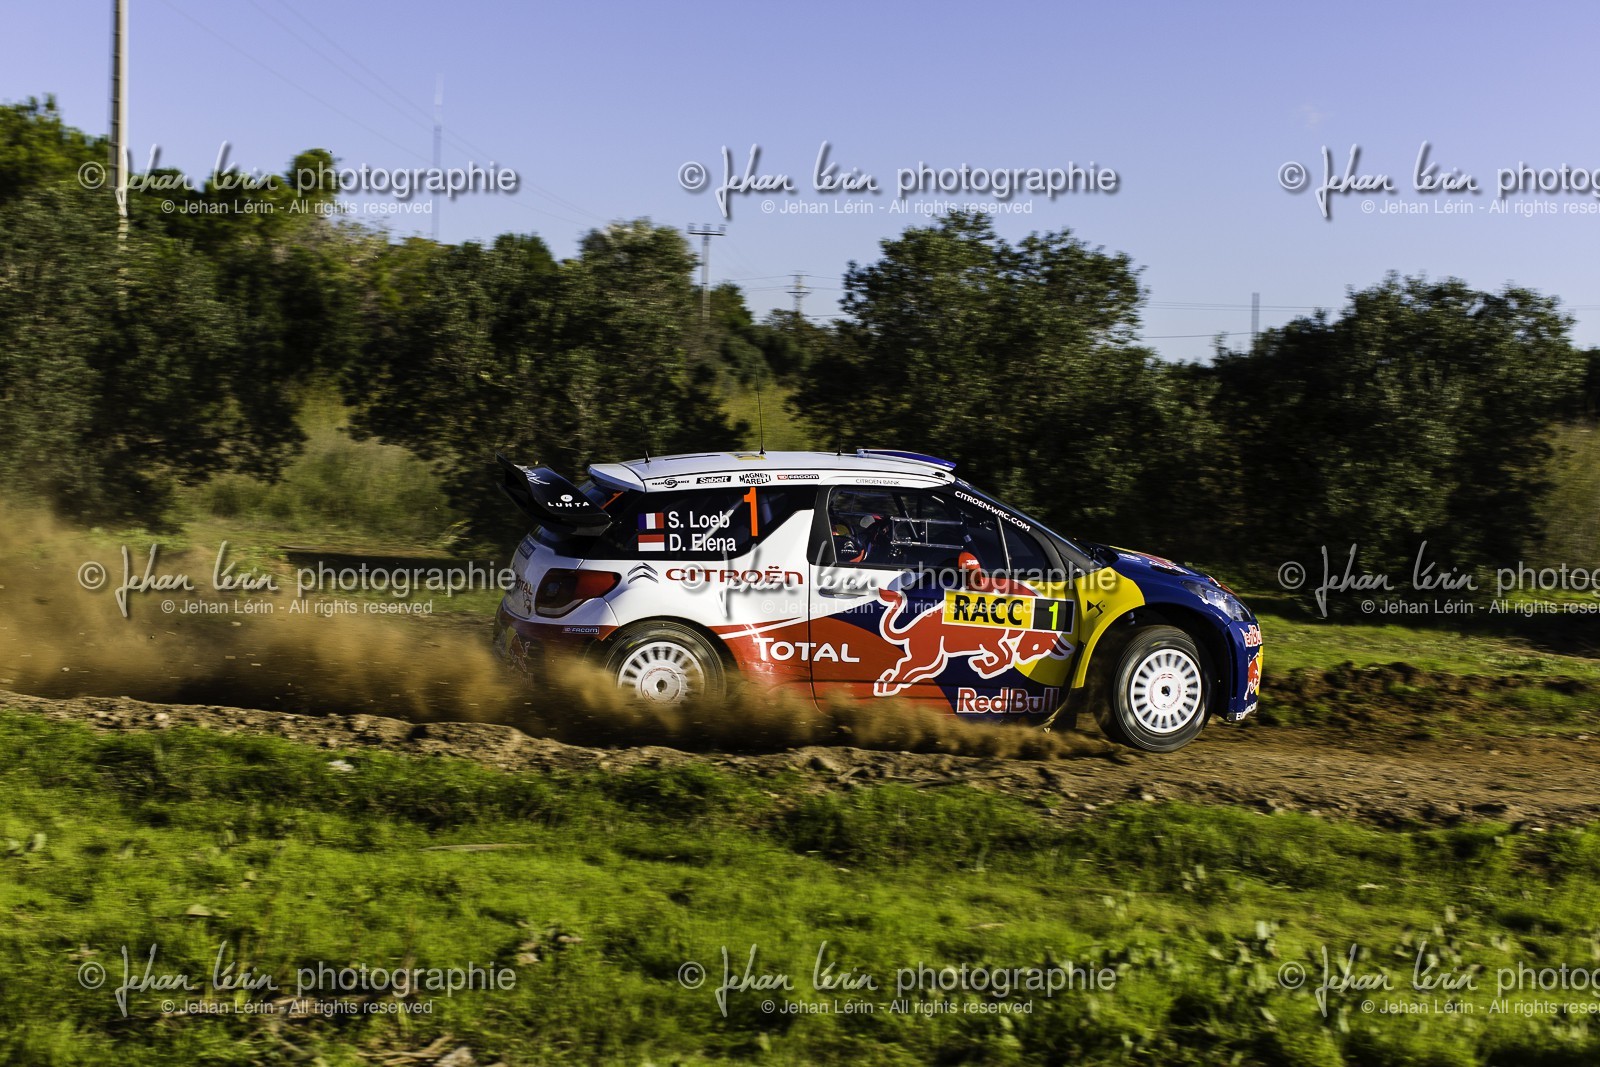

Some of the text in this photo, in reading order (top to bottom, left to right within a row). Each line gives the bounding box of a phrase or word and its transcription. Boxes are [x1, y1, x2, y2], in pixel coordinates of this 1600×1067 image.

[668, 511, 730, 529] S. Loeb
[744, 487, 758, 536] 1
[955, 490, 1031, 532] CITROEN-WRC.COM
[669, 534, 737, 552] D. Elena
[666, 565, 804, 585] CITROËN
[954, 594, 1059, 630] RACC 1
[753, 636, 860, 663] TOTAL
